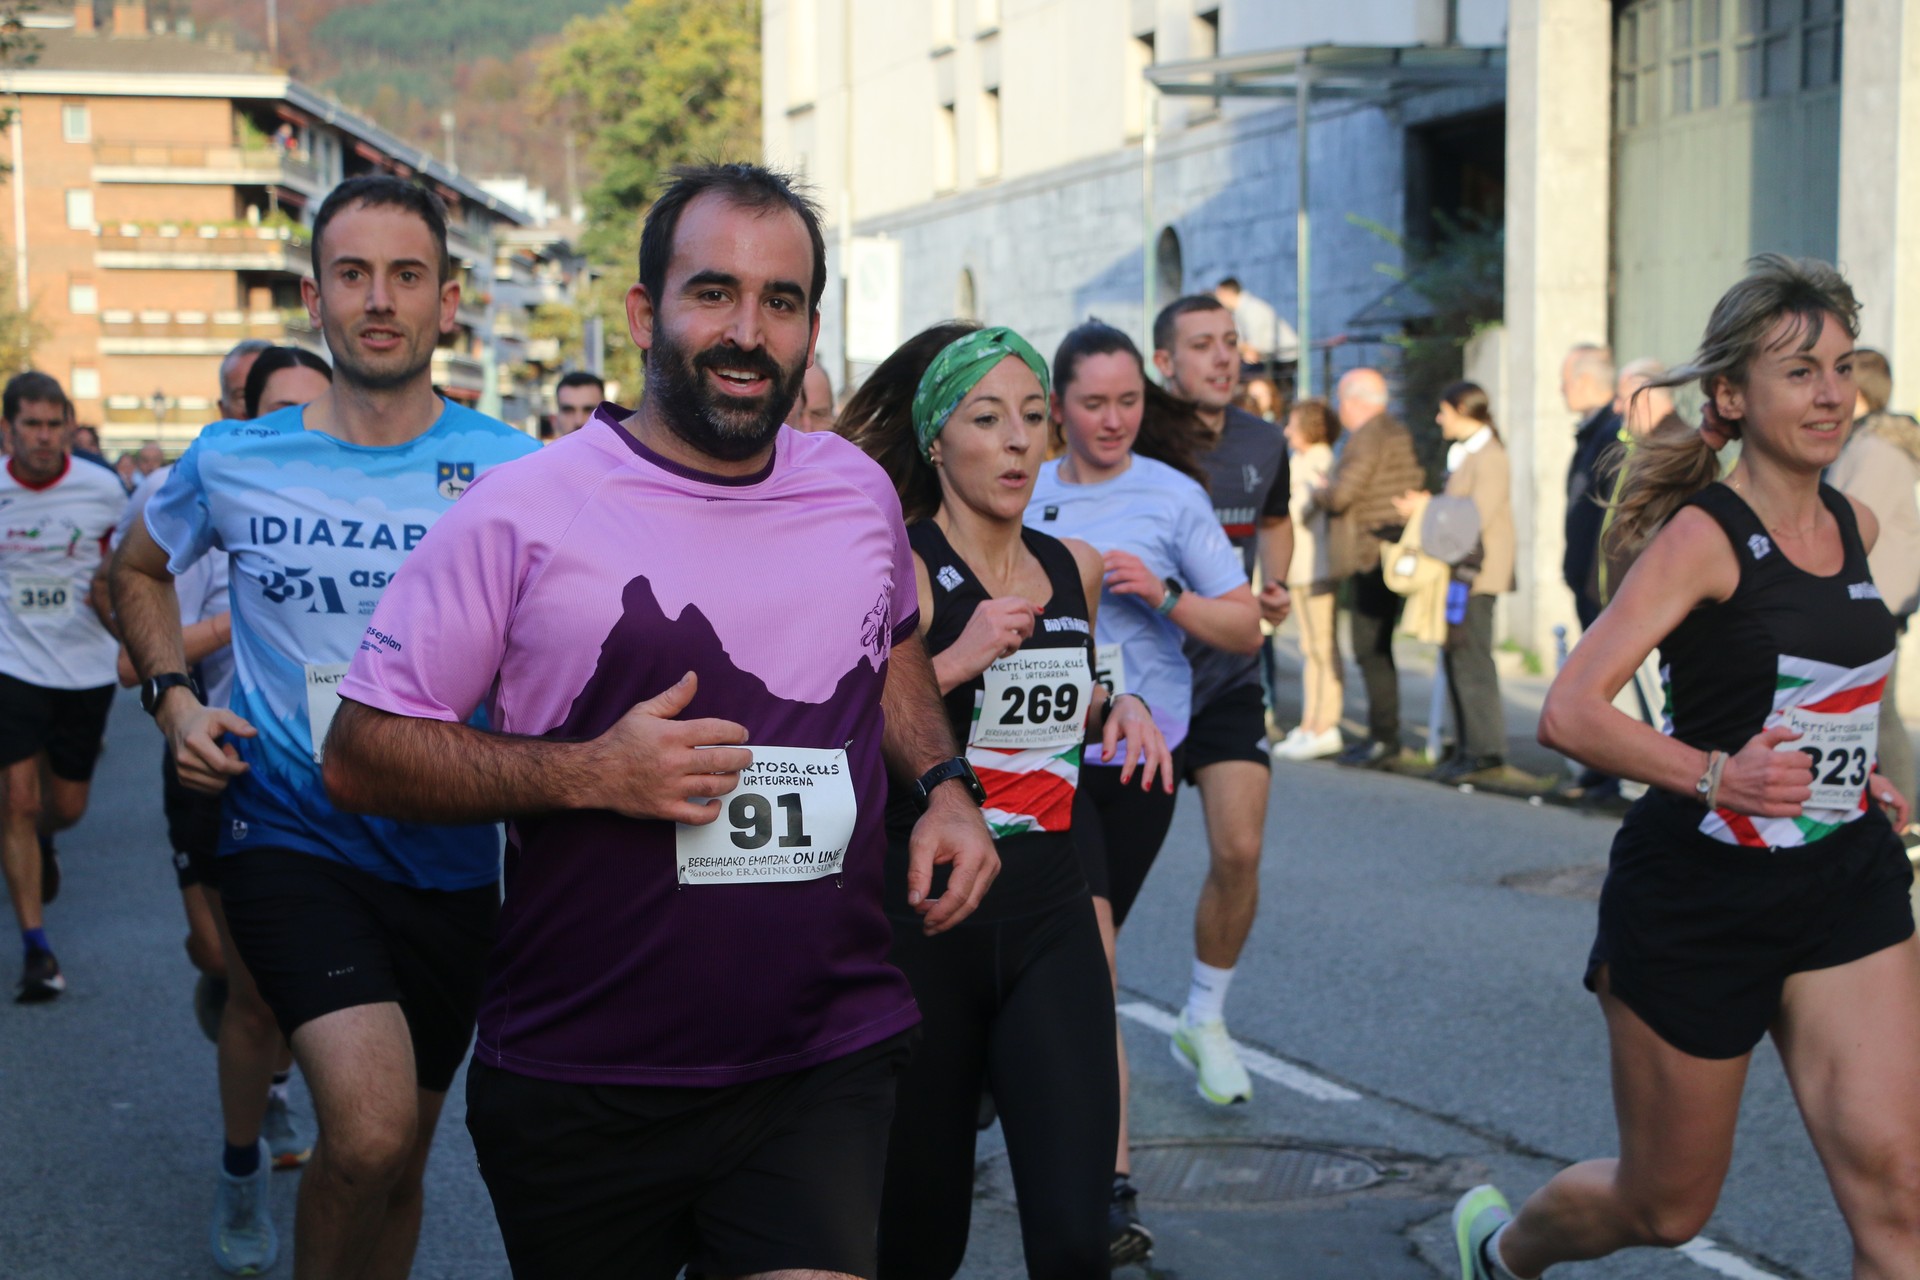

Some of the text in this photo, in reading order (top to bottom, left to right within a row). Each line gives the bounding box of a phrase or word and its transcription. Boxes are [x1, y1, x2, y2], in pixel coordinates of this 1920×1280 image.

[250, 516, 428, 551] IDIAZAB
[21, 589, 66, 607] 350
[366, 627, 402, 651] aseplan
[1026, 670, 1069, 680] URTEURRENA
[999, 683, 1078, 725] 269
[1048, 725, 1060, 735] ON
[743, 775, 814, 787] URTEURRENA
[728, 793, 811, 850] 91
[688, 848, 842, 868] BEREHALAKO EMAITZAK ON LINE
